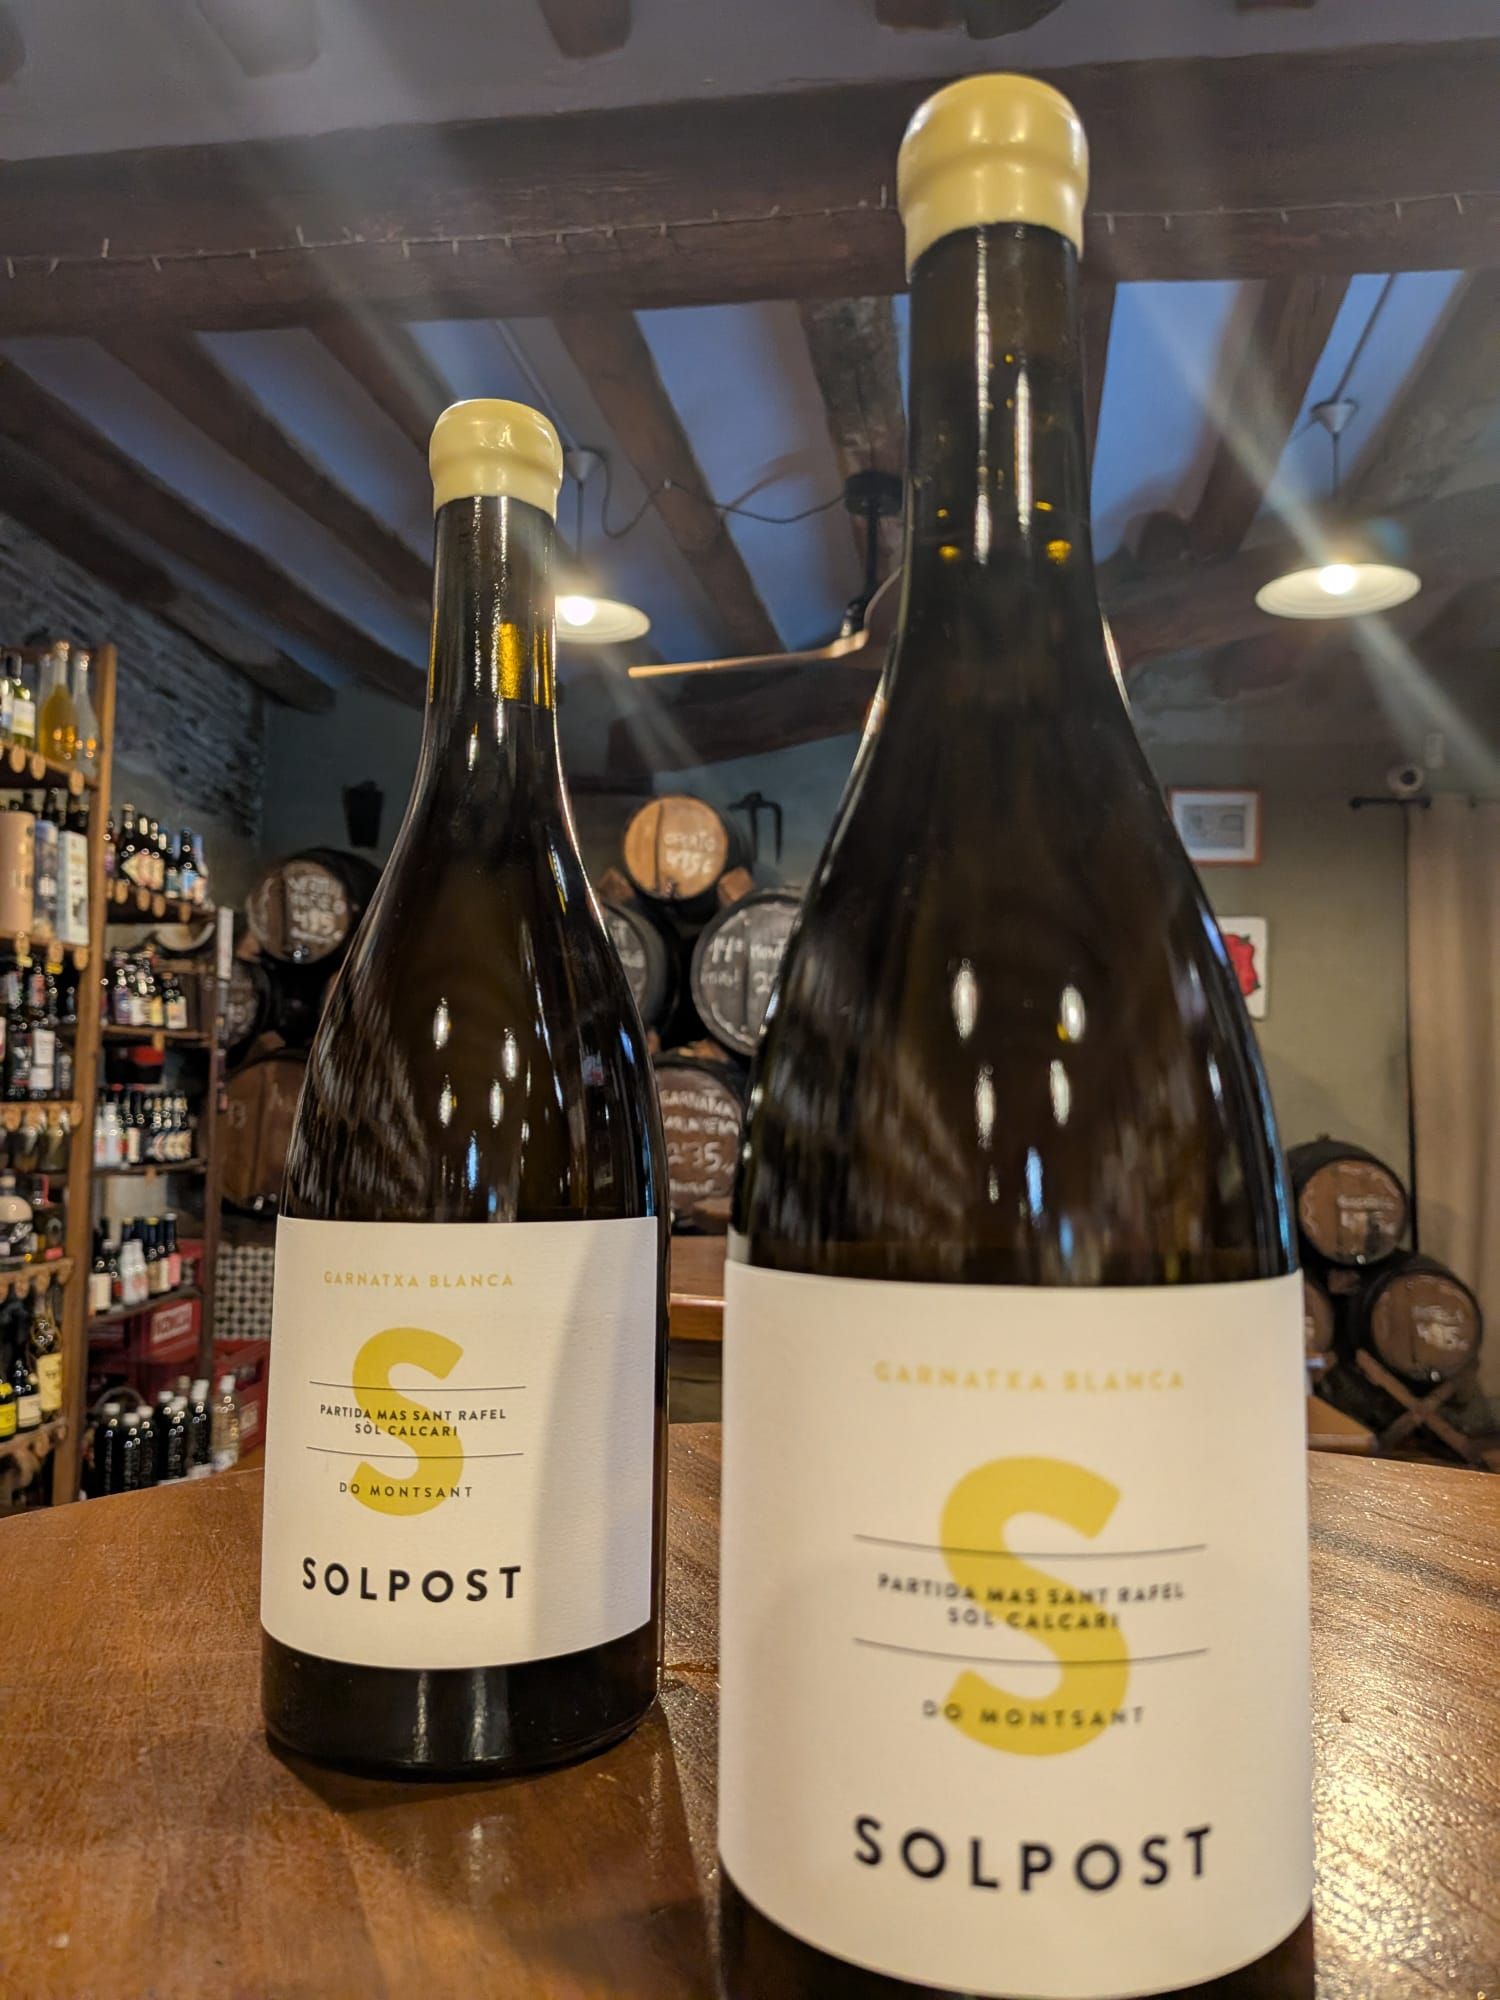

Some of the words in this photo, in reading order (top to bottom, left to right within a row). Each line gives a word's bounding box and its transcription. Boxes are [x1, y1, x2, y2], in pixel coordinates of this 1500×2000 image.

[323, 1271, 419, 1288] GARNATXA
[429, 1273, 513, 1288] BLANCA
[873, 1360, 1048, 1391] GARNATXA
[1063, 1368, 1185, 1392] BLANCA
[320, 1404, 371, 1419] PARTIDA
[377, 1409, 407, 1420] MAS
[413, 1410, 452, 1421] SANT
[458, 1409, 507, 1420] RAFEL
[352, 1327, 464, 1516] S
[355, 1421, 381, 1435] SÒL
[388, 1425, 458, 1437] CALCARI
[339, 1482, 360, 1495] DO
[370, 1486, 473, 1498] MONTSANT
[302, 1556, 522, 1603] SOLPOST
[878, 1573, 976, 1601] PARTIDA
[986, 1587, 1038, 1605] MAS
[1049, 1587, 1109, 1606] SANT
[1118, 1583, 1185, 1603] RAFEL
[941, 1456, 1129, 1755] S
[1005, 1611, 1120, 1630] CALCARI
[922, 1700, 962, 1721] DO
[980, 1705, 1145, 1728] MONTSANT
[854, 1814, 1212, 1893] SOLPOST
